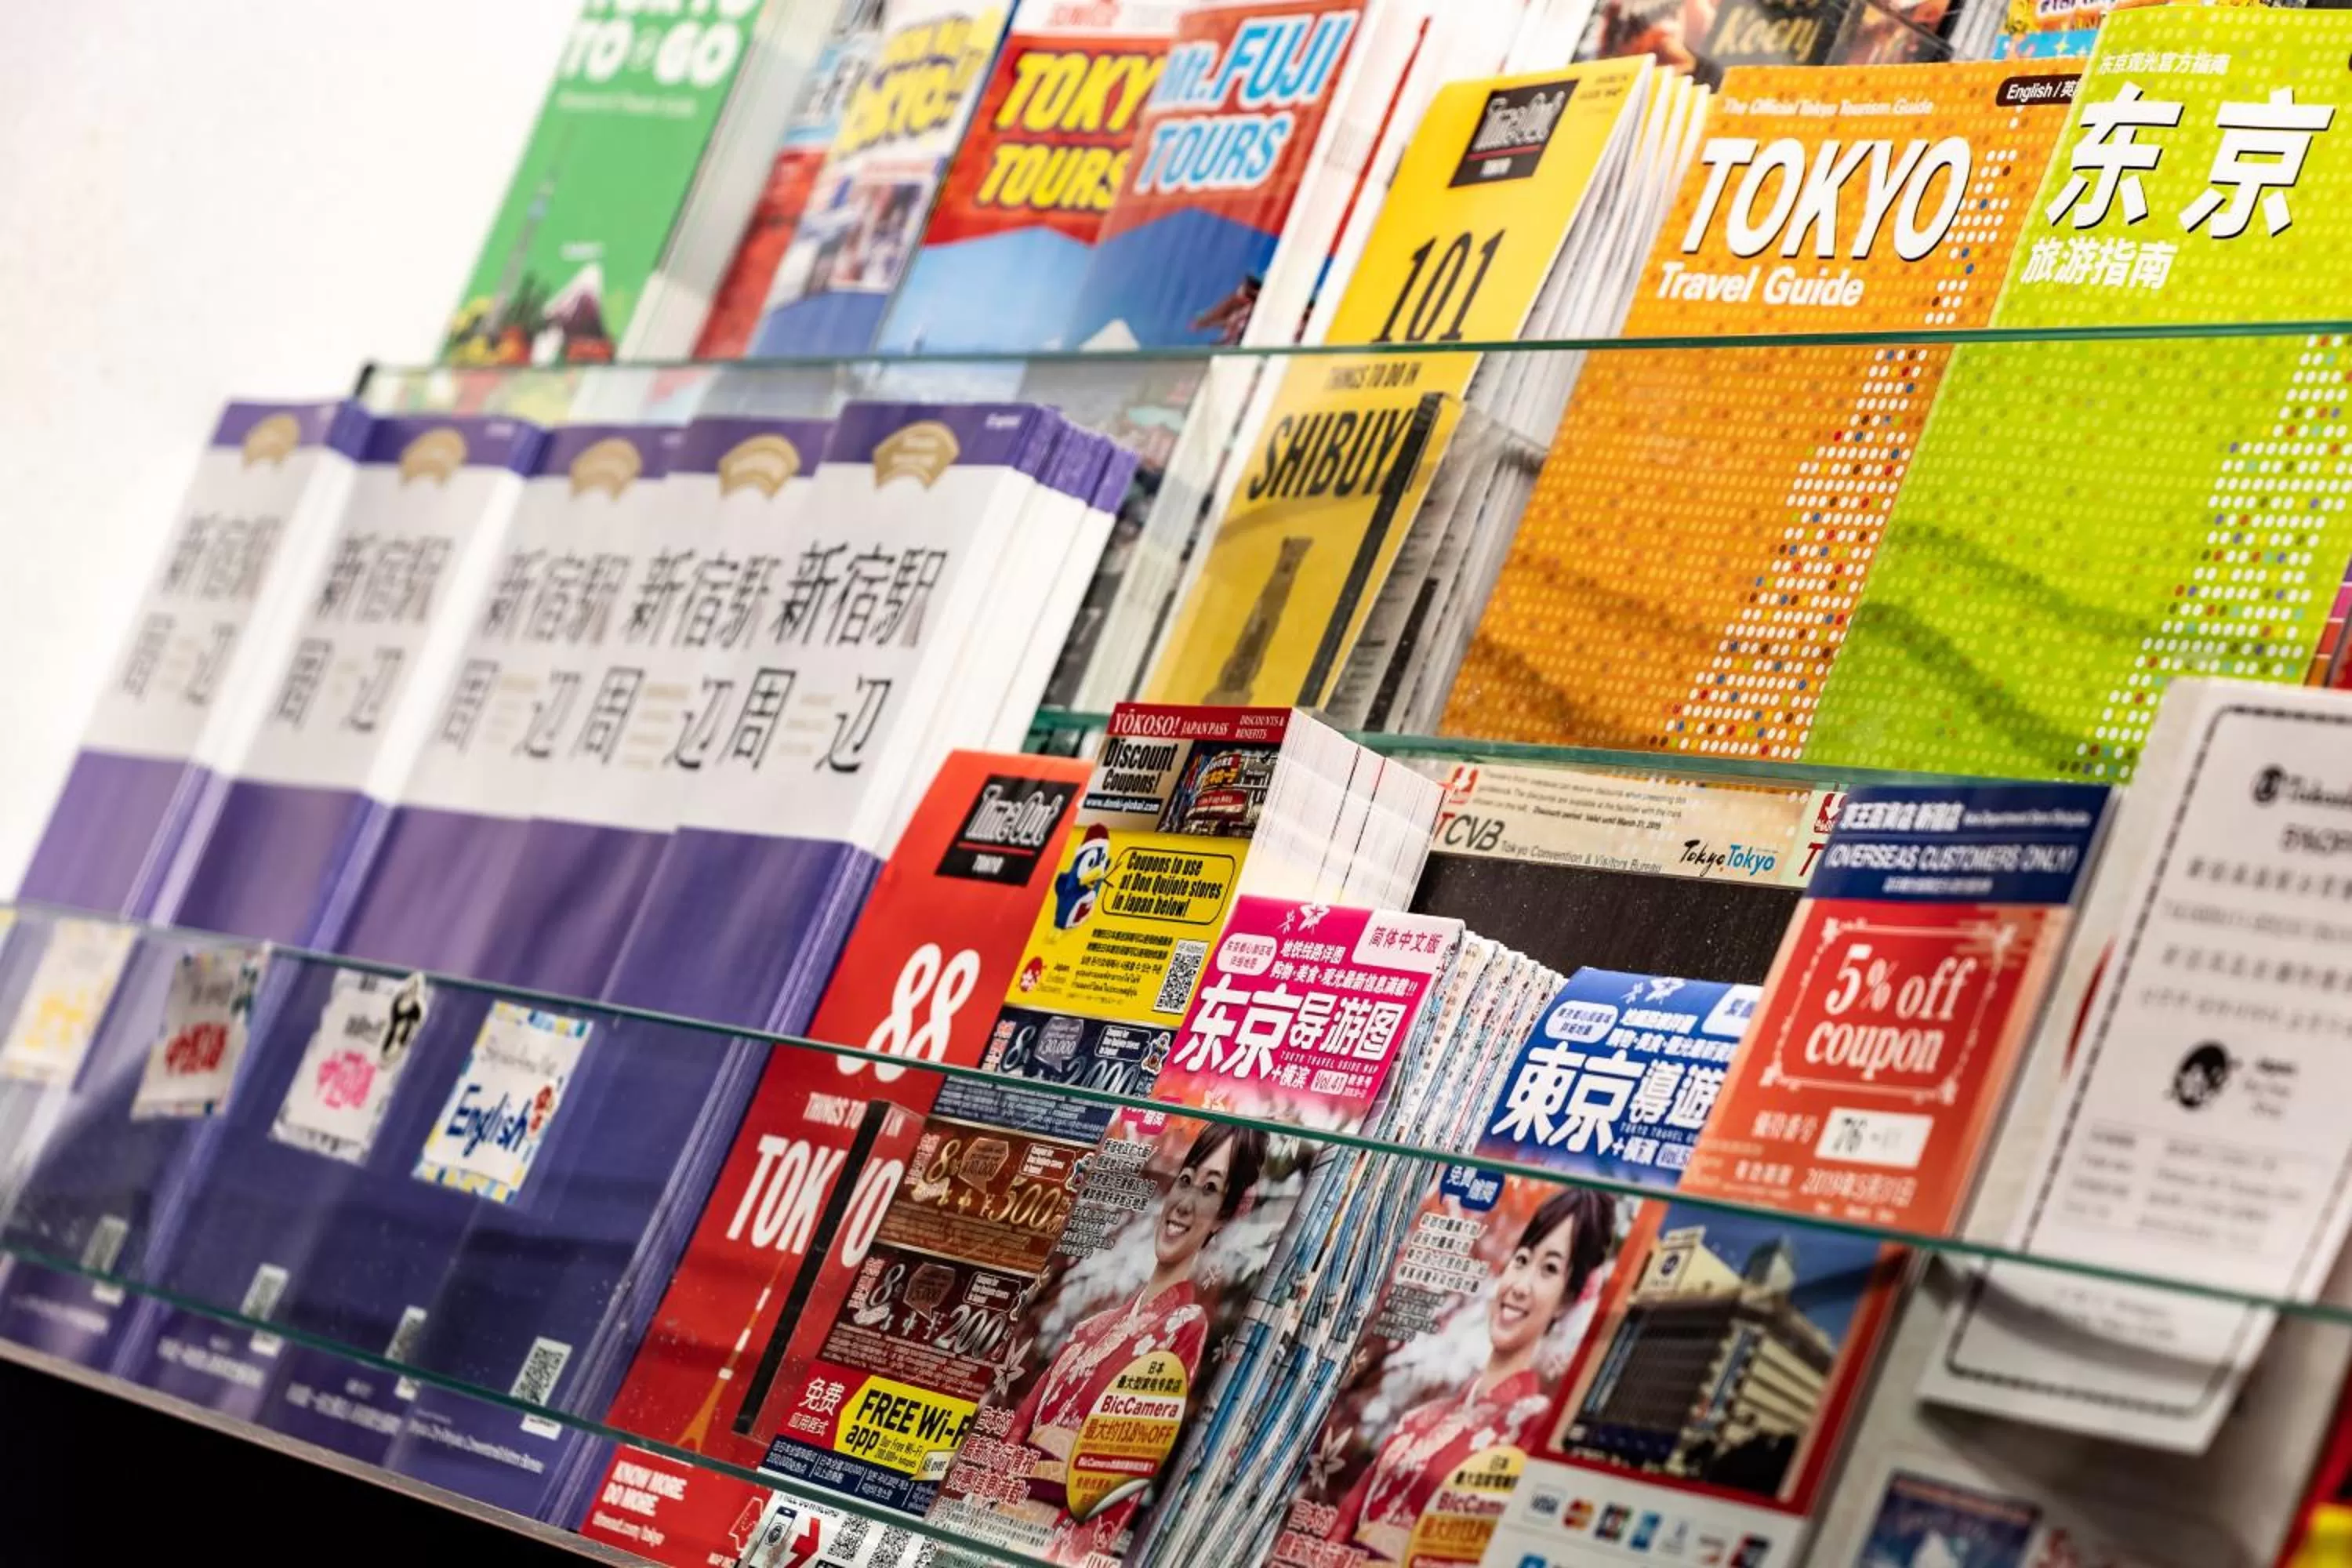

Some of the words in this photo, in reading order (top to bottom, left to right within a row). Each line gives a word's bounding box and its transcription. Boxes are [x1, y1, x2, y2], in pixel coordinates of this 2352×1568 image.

[996, 52, 1167, 132] TOKY
[1839, 99, 1890, 116] Tourism
[1893, 97, 1934, 115] Guide
[2006, 82, 2053, 102] English
[1134, 113, 1296, 196] TOURS
[2045, 80, 2336, 238] 东京
[1680, 136, 1973, 262] TOKYO
[2020, 238, 2178, 289] 旅游指南
[1369, 229, 1505, 343] 101
[1654, 261, 1752, 302] Travel
[1762, 265, 1865, 307] Guide
[1207, 722, 1229, 736] PASS
[1103, 738, 1178, 771] Discount
[1102, 768, 1163, 794] Coupons!
[1127, 851, 1171, 873] Coupons
[1171, 856, 1184, 874] to
[1182, 860, 1203, 876] use
[1501, 840, 1529, 857] Tokyo
[1530, 844, 1584, 863] Convention
[1595, 854, 1628, 869] Visitors
[1679, 839, 1725, 877] Tokyo
[1725, 843, 1775, 876] Tokyo
[1111, 891, 1125, 909] in
[1123, 892, 1155, 913] Japan
[1153, 894, 1192, 916] below!
[1120, 873, 1133, 890] at
[1131, 873, 1153, 891] Don
[1152, 874, 1189, 897] Quijote
[1189, 880, 1224, 899] stores
[1371, 926, 1443, 954] 简体中文版
[1824, 944, 1898, 1013] 5%
[1896, 956, 1978, 1022] off
[836, 942, 980, 1083] 88
[1174, 974, 1407, 1079] 东京导游图
[1804, 1021, 1945, 1081] coupon
[1492, 1041, 1730, 1156] 東京導遊
[446, 1083, 532, 1157] English
[1148, 1361, 1165, 1374] 日本
[798, 1377, 845, 1417] 免费
[1101, 1395, 1179, 1418] BicCamera
[855, 1388, 921, 1435] FREE
[916, 1406, 972, 1448] Wi-F
[845, 1423, 880, 1456] app
[1436, 1492, 1509, 1514] BicCam
